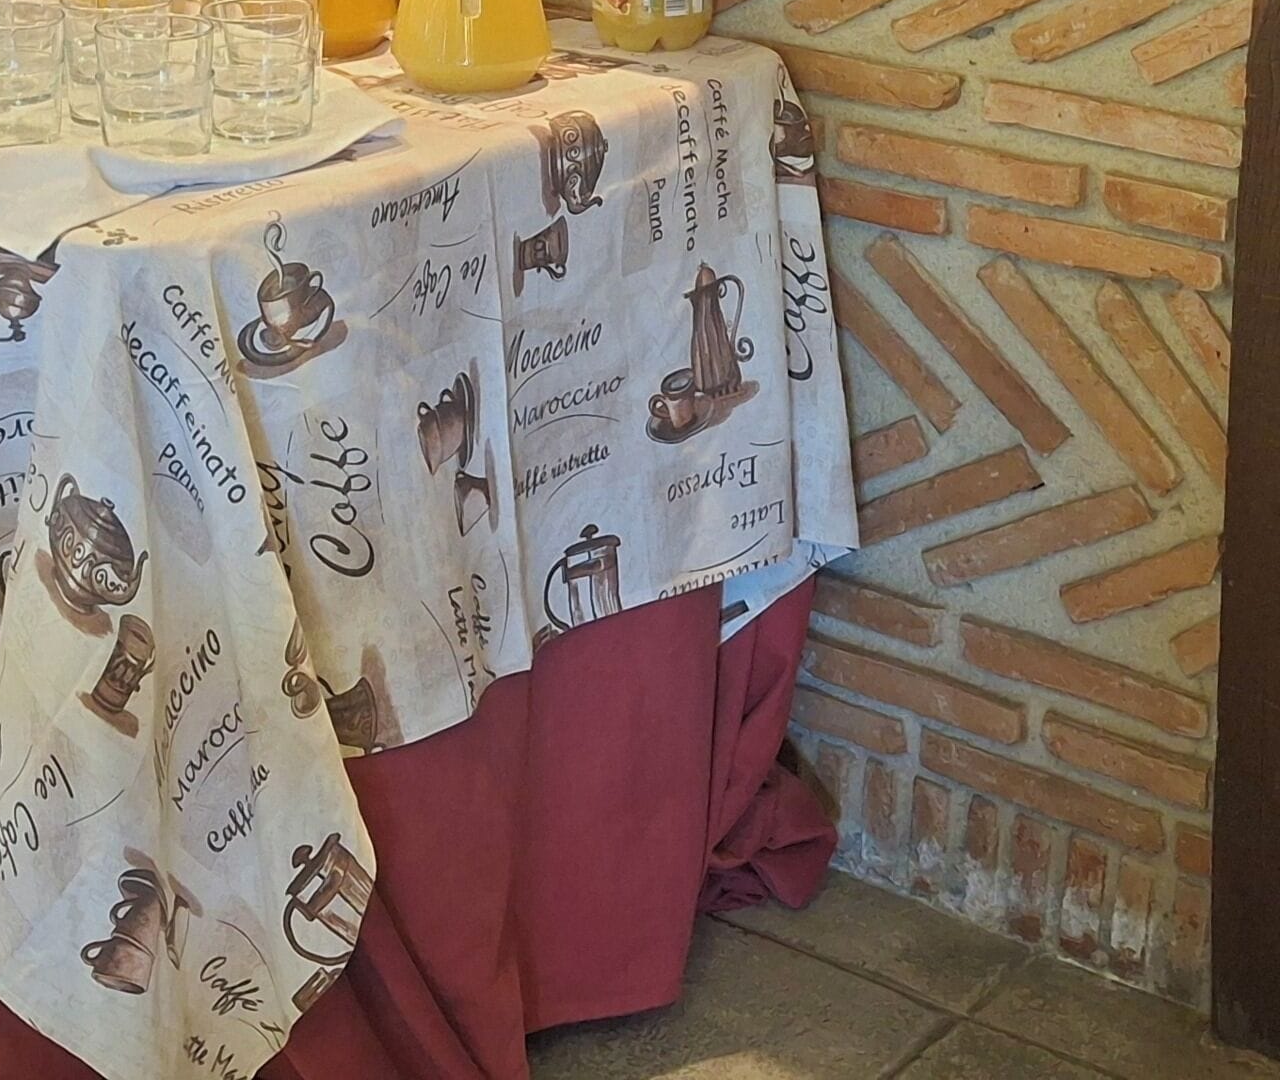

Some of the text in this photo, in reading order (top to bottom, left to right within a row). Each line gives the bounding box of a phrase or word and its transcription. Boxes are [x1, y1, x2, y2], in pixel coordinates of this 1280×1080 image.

[706, 77, 731, 220] Caffé Mocha
[371, 177, 460, 229] Americano
[652, 177, 667, 243] Panna
[412, 253, 487, 317] Ice Café
[162, 284, 221, 358] Caffé
[120, 320, 247, 505] decaffeinato
[512, 375, 626, 434] Maroccino
[158, 442, 206, 514] Panna
[551, 443, 611, 480] ristretto
[667, 451, 759, 503] Espresso
[730, 499, 785, 531] Latte
[447, 585, 468, 647] Latte
[34, 753, 74, 800] Ice
[171, 702, 243, 813] Maroc
[199, 956, 265, 1016] Caffé
